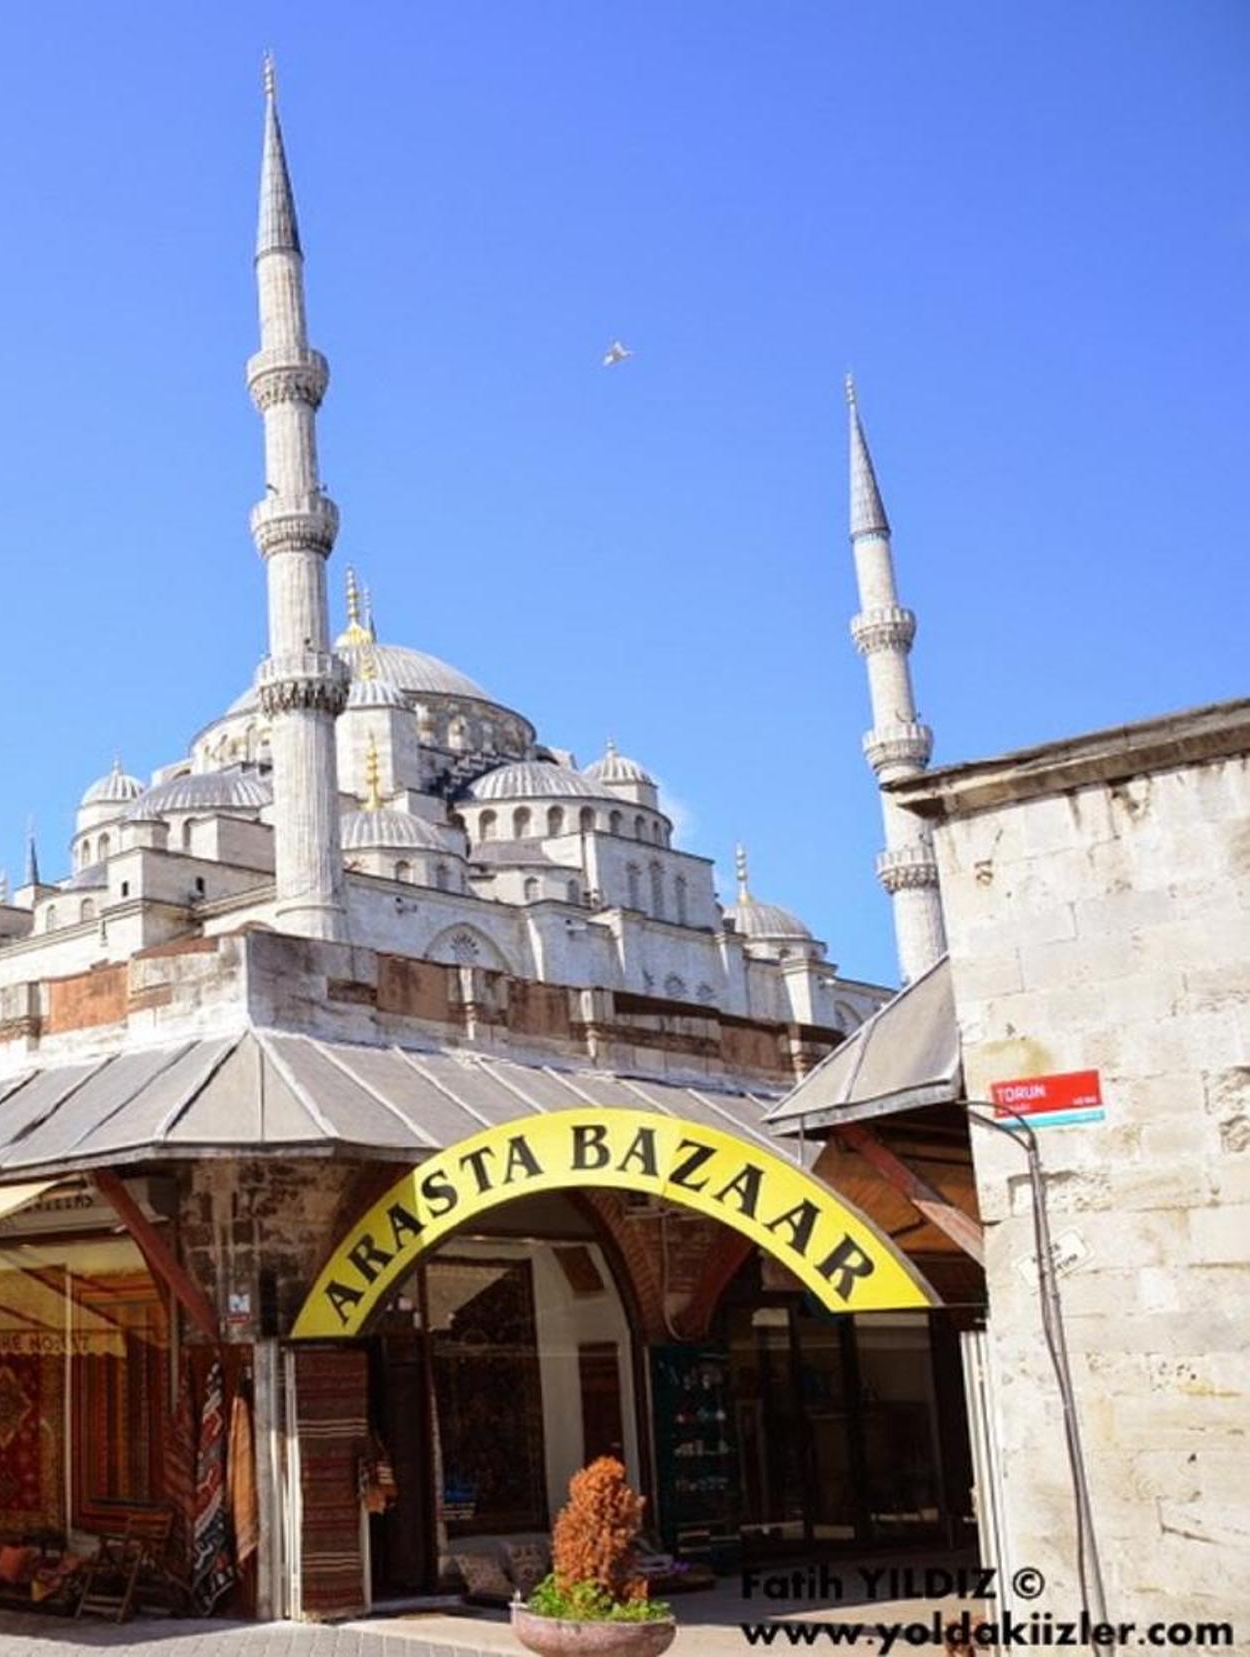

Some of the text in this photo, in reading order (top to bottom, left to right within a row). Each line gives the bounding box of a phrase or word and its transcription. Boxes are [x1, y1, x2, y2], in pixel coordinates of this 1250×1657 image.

[997, 1085, 1046, 1103] TORUN
[324, 1124, 877, 1326] ARASTA BAZAAR
